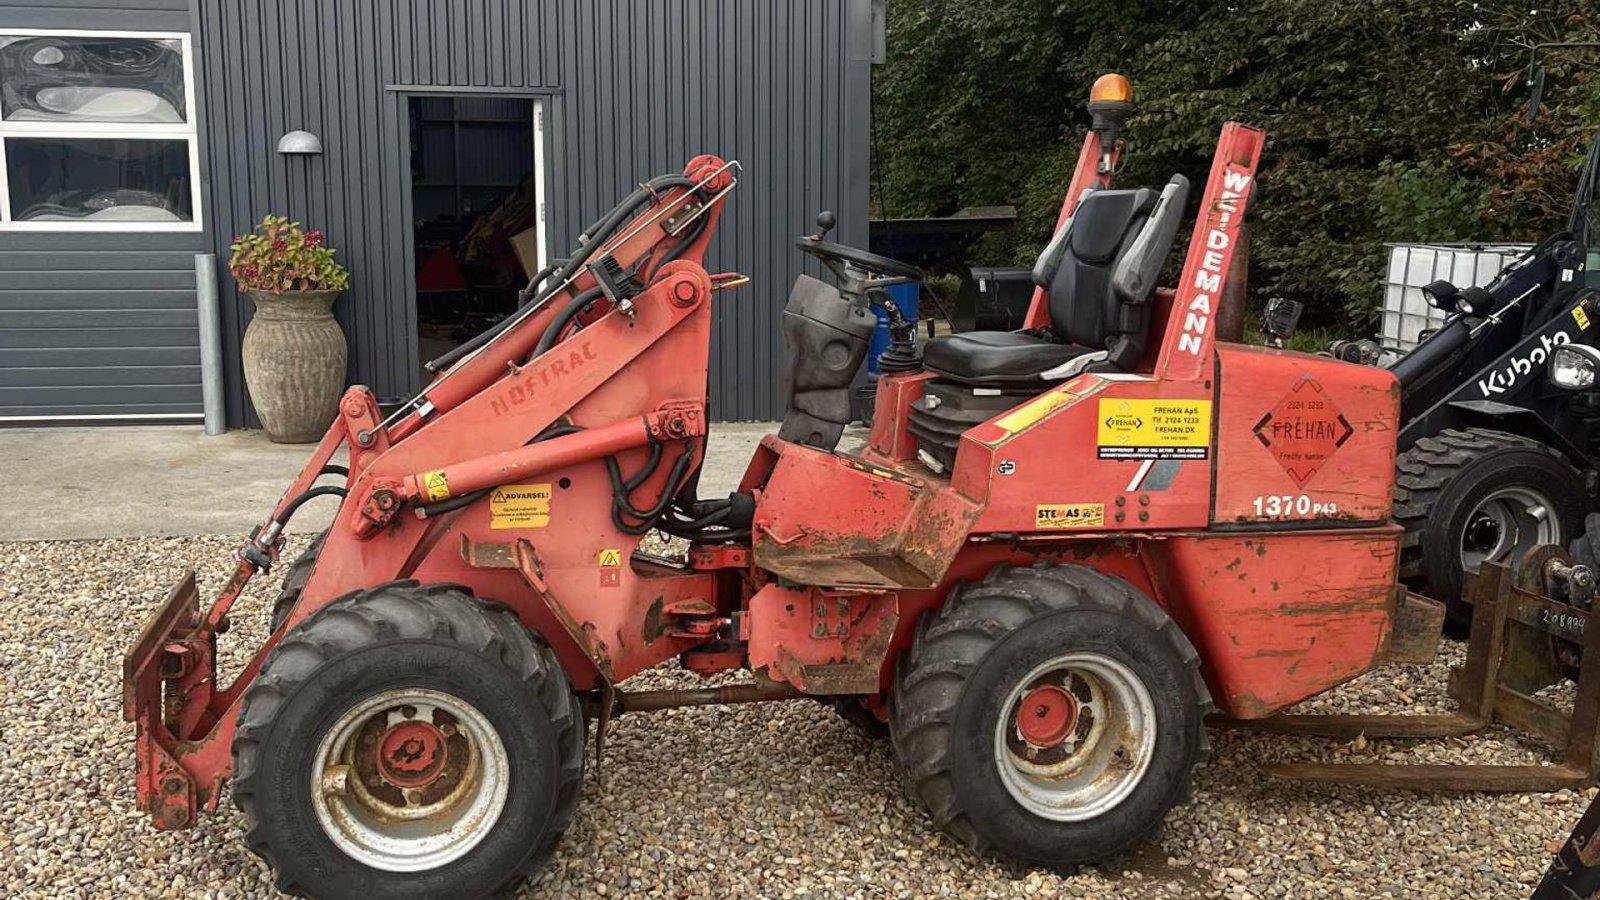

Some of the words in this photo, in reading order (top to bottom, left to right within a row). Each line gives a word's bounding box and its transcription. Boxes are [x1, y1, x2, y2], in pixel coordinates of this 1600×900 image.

[1178, 169, 1250, 355] WEIDEMANN
[1478, 331, 1571, 397] Kubota
[1154, 406, 1182, 414] FREHAN
[1184, 407, 1199, 415] ApS
[1111, 419, 1137, 427] FREHAN
[1184, 416, 1199, 424] 1233
[1272, 421, 1335, 439] FREHAN
[505, 492, 549, 500] ADVARSEL!
[1253, 495, 1311, 515] 1370
[1313, 503, 1337, 514] P43
[1038, 508, 1080, 518] STEMAS
